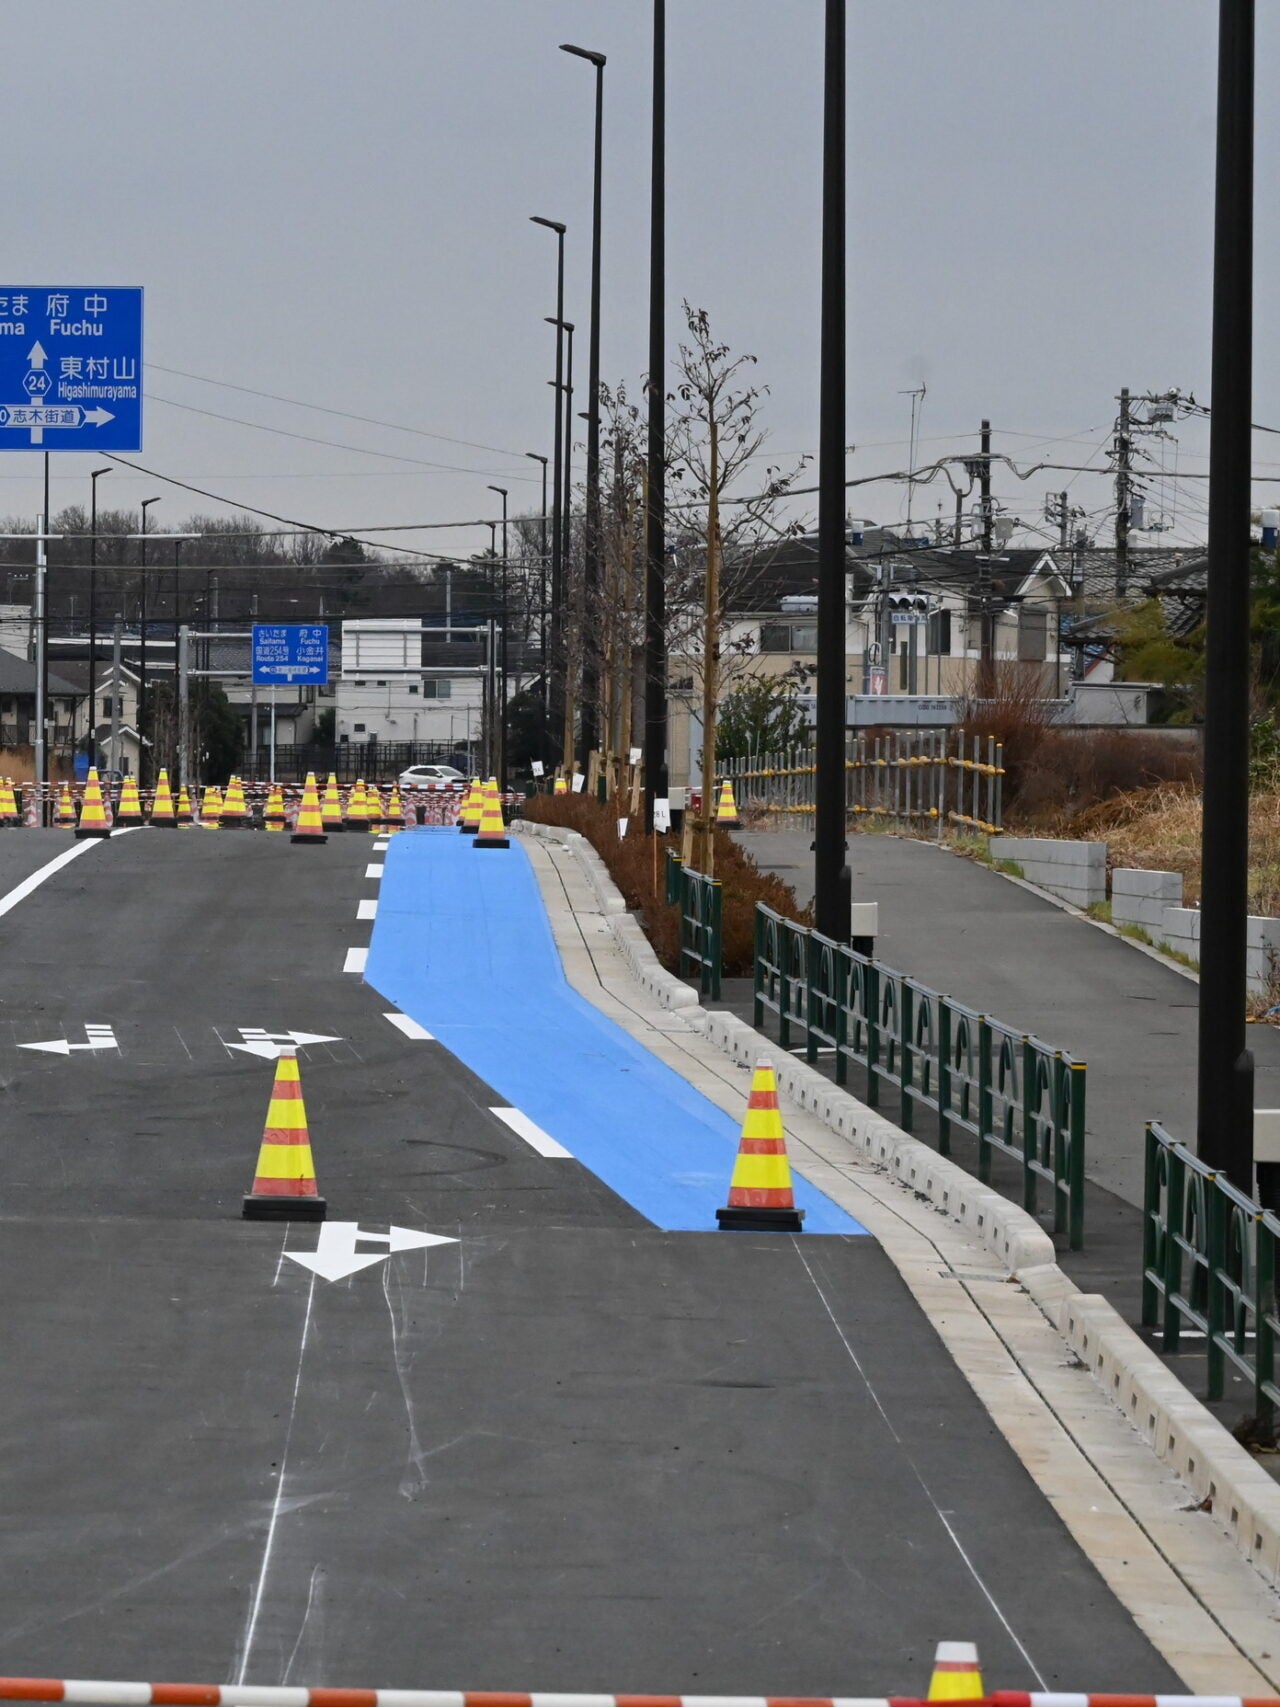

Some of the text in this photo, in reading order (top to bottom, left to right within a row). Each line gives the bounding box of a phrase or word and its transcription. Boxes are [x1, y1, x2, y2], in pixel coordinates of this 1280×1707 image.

[46, 293, 108, 318] 府中
[50, 319, 103, 336] Fuchu
[59, 355, 136, 380] 東村山
[28, 376, 46, 391] 24
[58, 381, 137, 402] Higashimurayama
[12, 408, 75, 424] 志木街道
[258, 629, 287, 638] さいたま
[296, 646, 324, 655] 小金井
